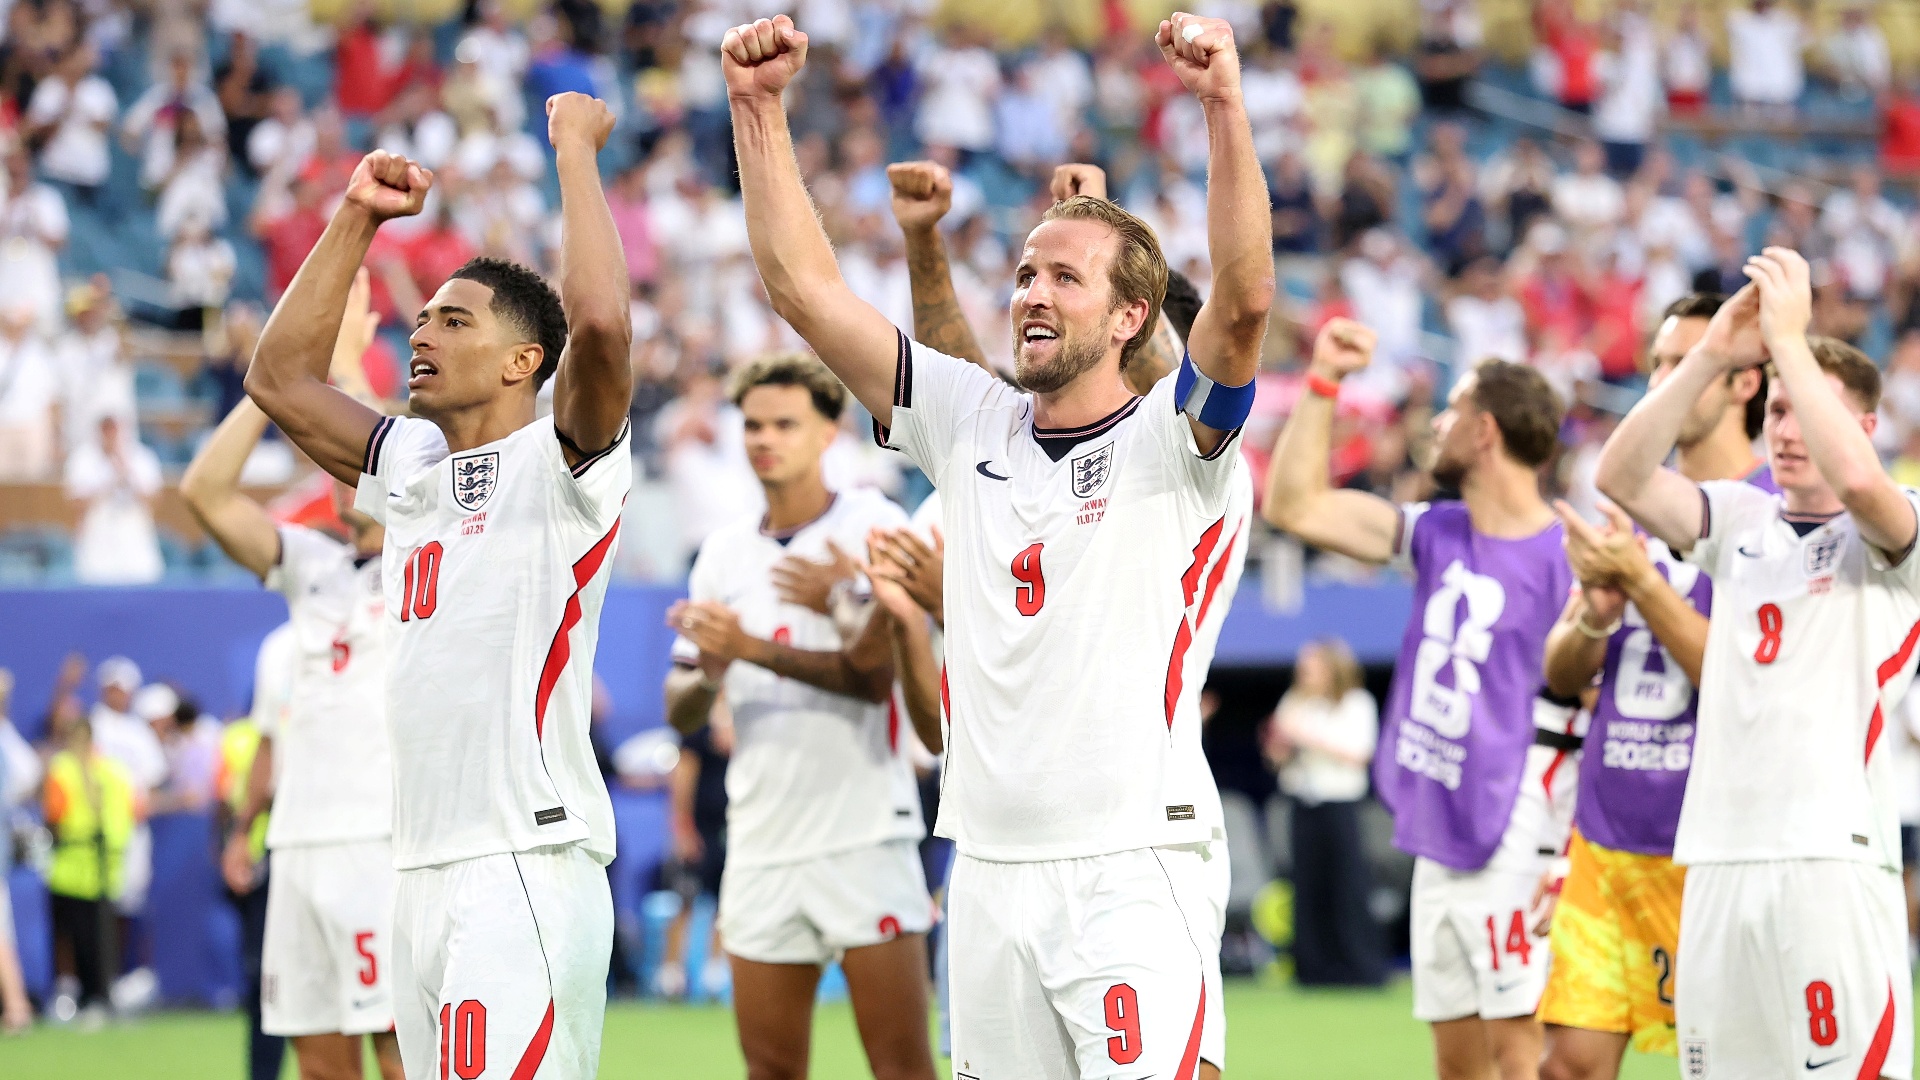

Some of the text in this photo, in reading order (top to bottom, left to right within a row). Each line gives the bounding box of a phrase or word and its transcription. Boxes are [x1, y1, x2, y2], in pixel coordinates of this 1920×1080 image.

[1080, 497, 1107, 512] RWAY
[401, 540, 444, 622] 10
[1010, 542, 1046, 617] 9
[1753, 602, 1783, 665] 8
[1603, 739, 1691, 771] 2026
[1652, 723, 1694, 743] CUP
[355, 931, 377, 985] 5
[1486, 910, 1531, 971] 14
[439, 999, 487, 1080] 10
[1103, 982, 1143, 1066] 9
[1805, 980, 1838, 1046] 8
